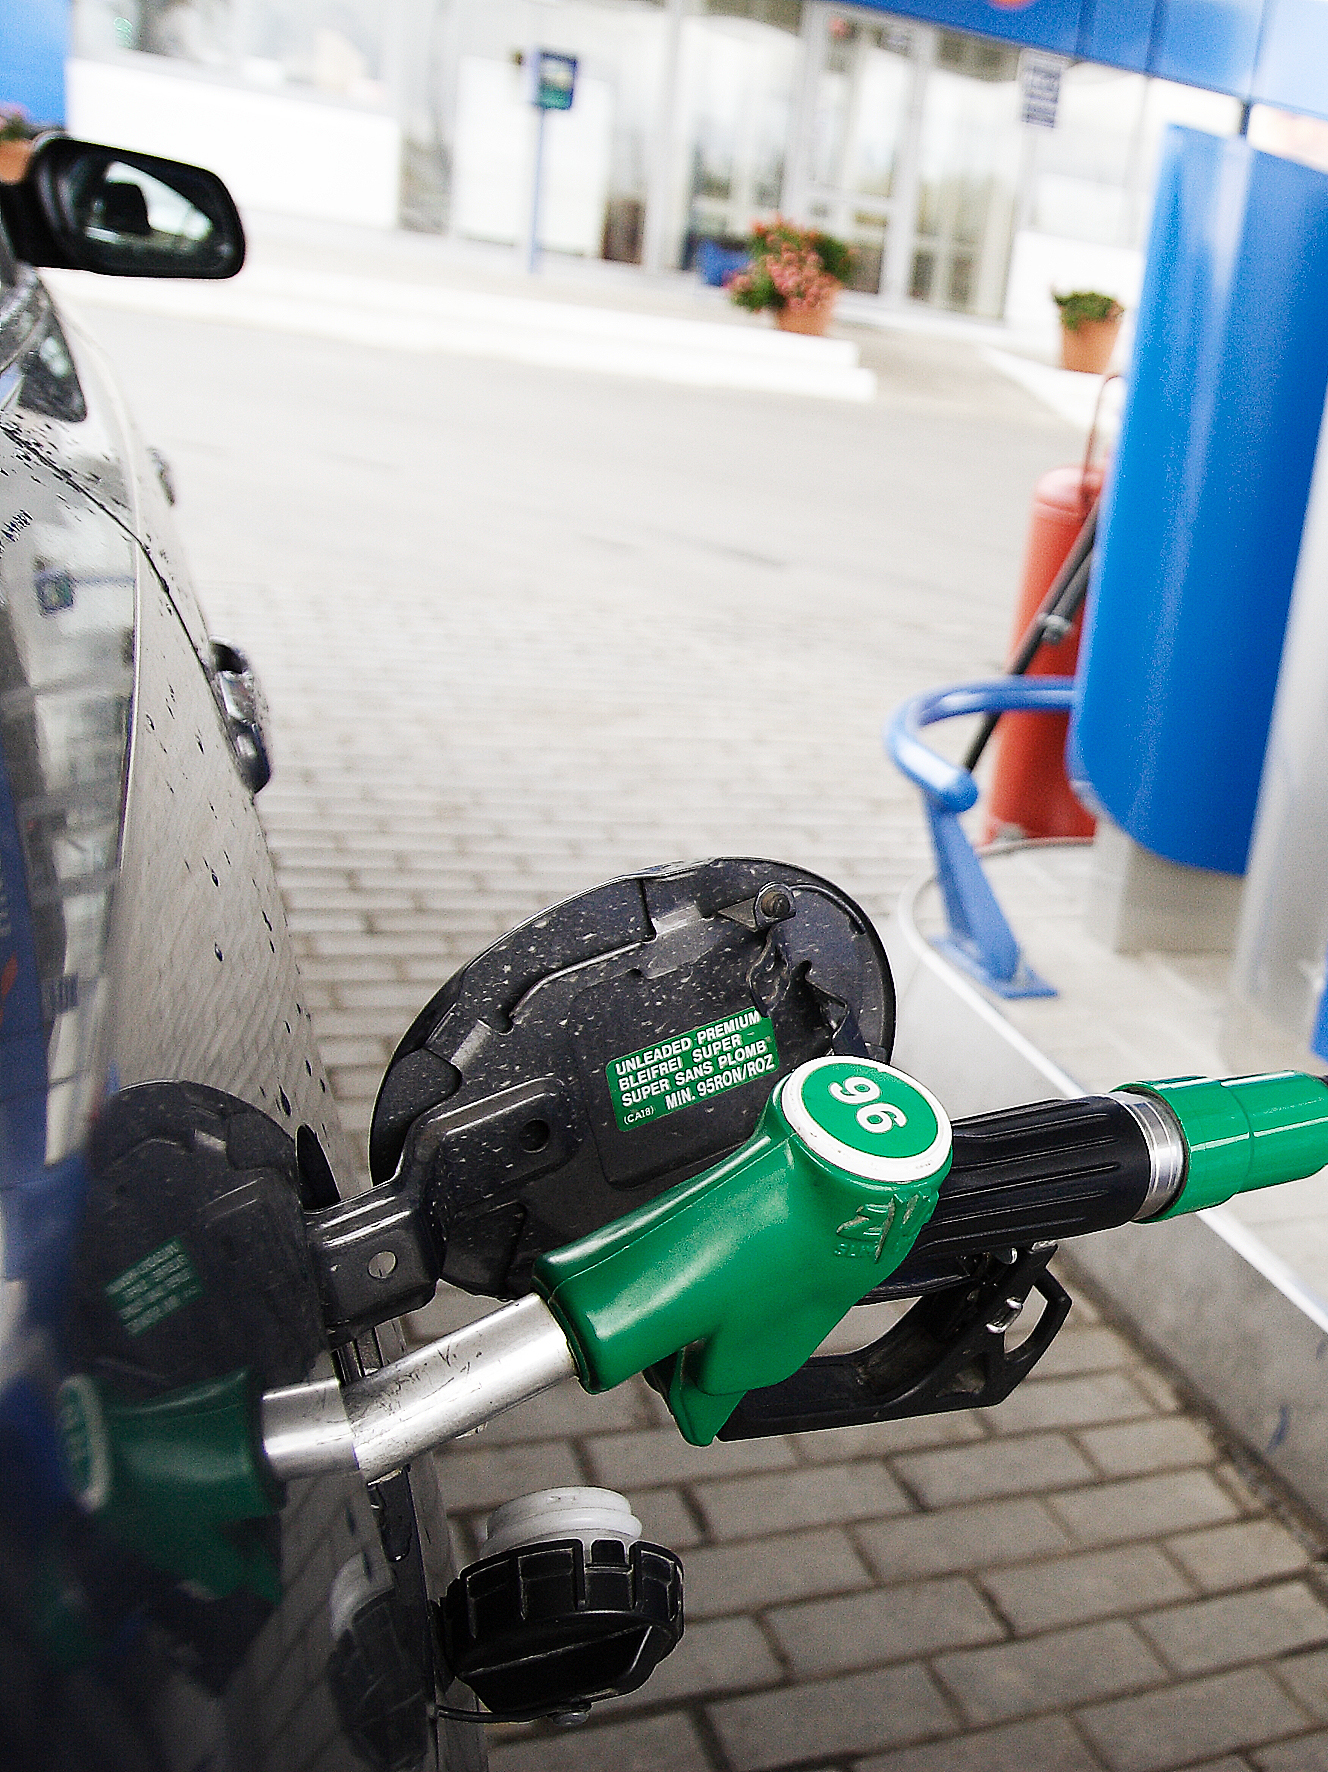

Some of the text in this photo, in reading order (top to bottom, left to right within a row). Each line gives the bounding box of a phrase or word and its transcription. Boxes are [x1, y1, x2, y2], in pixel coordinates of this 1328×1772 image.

[615, 1010, 762, 1075] UNLEADED PREMIUM
[618, 1033, 742, 1091] BLEIFREI SUPER
[621, 1040, 767, 1107] SUPER SANS PLOMB
[664, 1053, 775, 1110] MIN. 95RON/ROZ
[829, 1076, 907, 1133] 96
